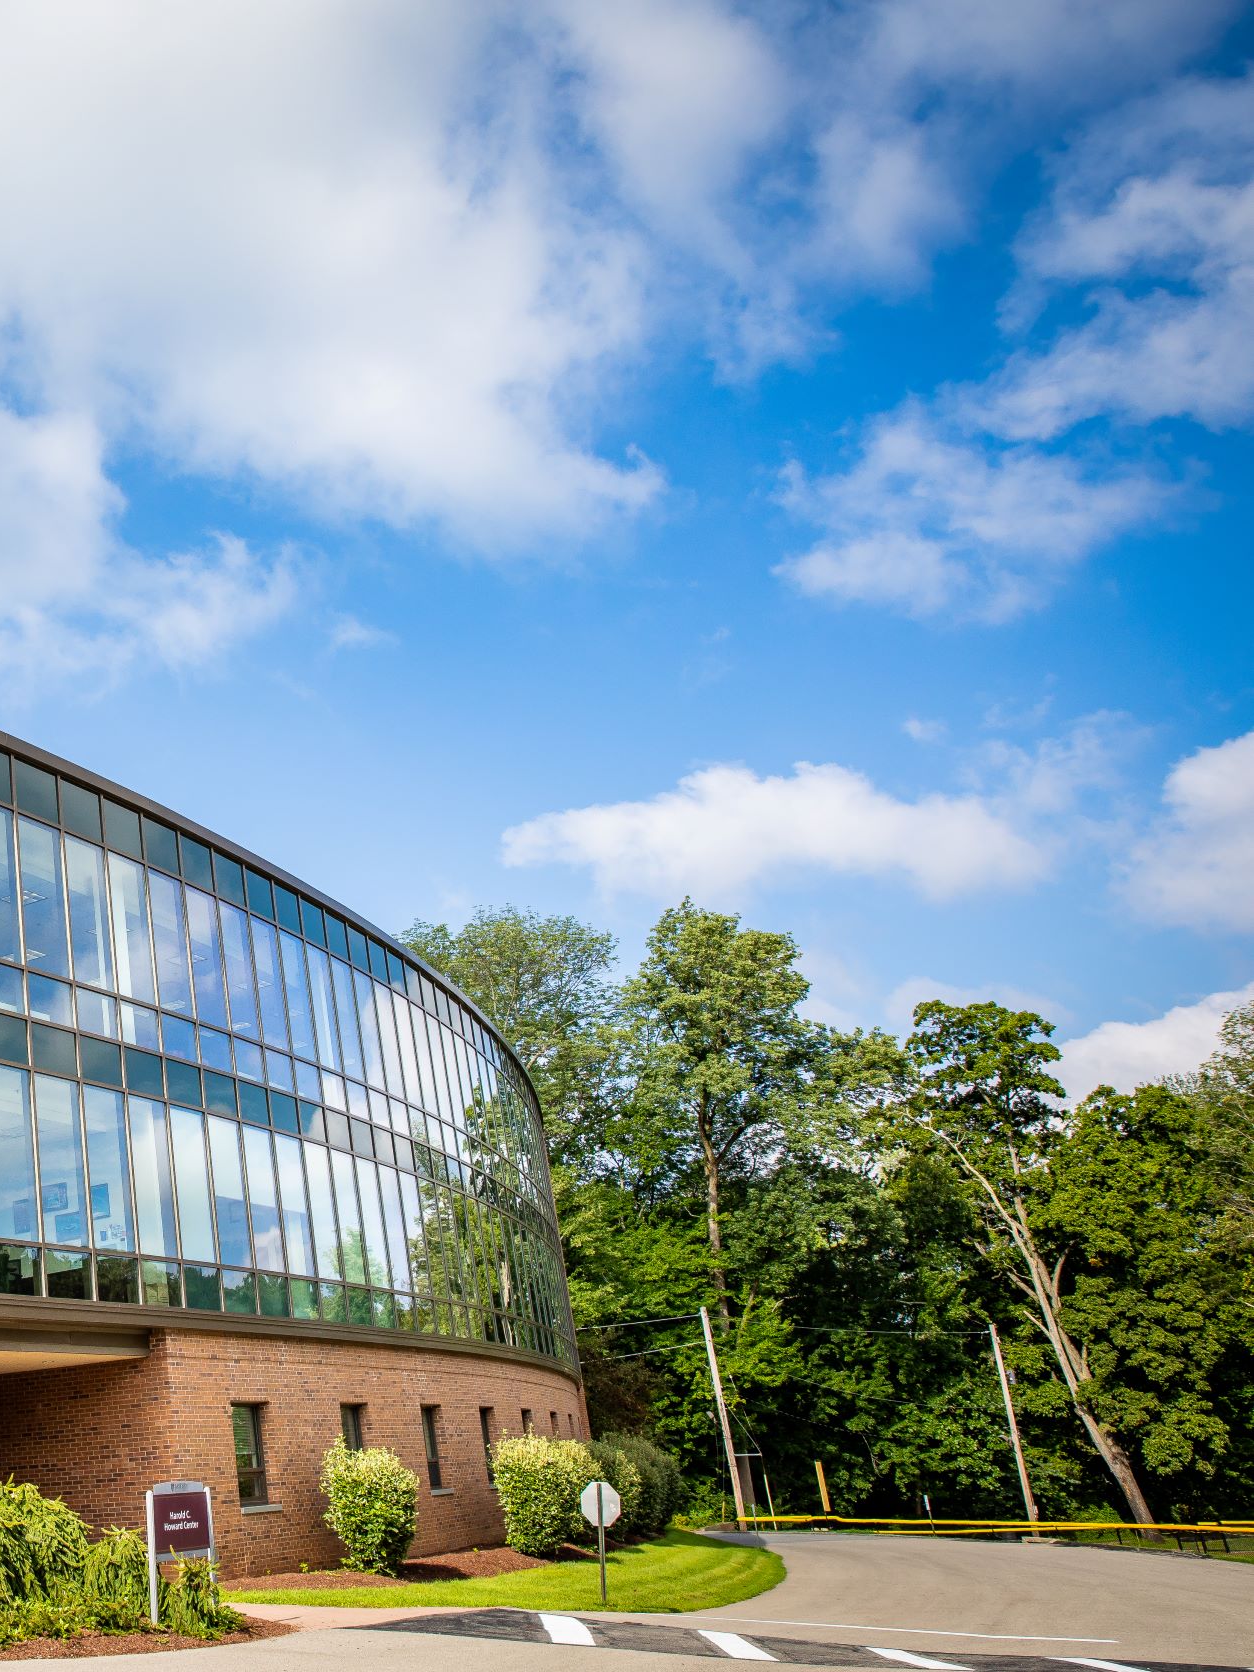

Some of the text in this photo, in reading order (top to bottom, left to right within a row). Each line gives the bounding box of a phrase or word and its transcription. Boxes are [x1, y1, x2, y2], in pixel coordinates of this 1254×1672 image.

[170, 1510, 191, 1519] Harold C.
[164, 1521, 198, 1531] Howard Center
